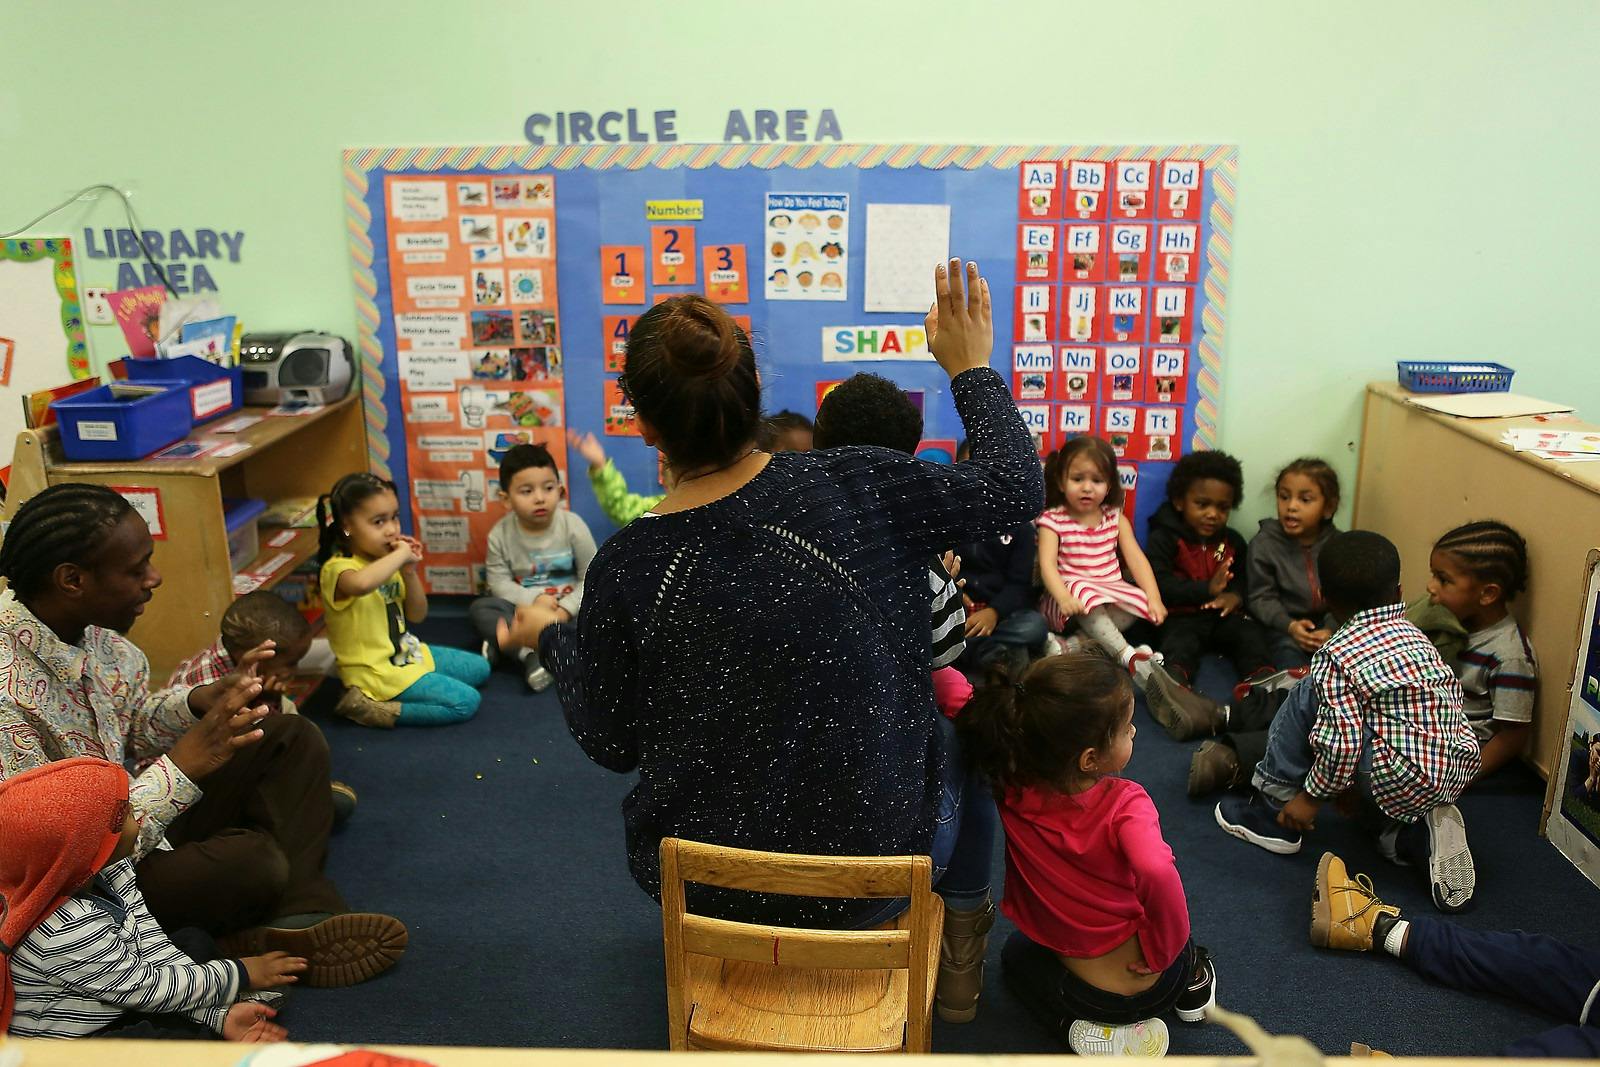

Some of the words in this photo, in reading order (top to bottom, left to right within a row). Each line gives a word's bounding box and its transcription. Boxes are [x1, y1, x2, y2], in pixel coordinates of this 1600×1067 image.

[523, 108, 679, 145] CIRCLE
[723, 109, 843, 142] AREA
[1029, 169, 1053, 185] Aa
[1076, 168, 1101, 185] Bb
[1123, 167, 1145, 184] Cc
[1167, 169, 1193, 185] Dd
[647, 205, 703, 216] Numbers
[84, 227, 245, 263] LIBRARY
[664, 229, 681, 253] 2
[1028, 230, 1049, 246] Ee
[1075, 231, 1092, 247] Ff
[1117, 229, 1140, 249] Gg
[1165, 232, 1190, 248] Hh
[615, 252, 630, 277] 1
[716, 247, 733, 271] 3
[117, 263, 219, 294] AREA
[1030, 291, 1040, 307] Ii
[1076, 292, 1089, 312] Jj
[1115, 293, 1136, 308] Kk
[1164, 295, 1177, 311] Ll
[614, 318, 630, 341] 4
[835, 330, 931, 354] SHAP
[1016, 352, 1051, 368] Mm
[1066, 352, 1091, 367] Nn
[1111, 354, 1136, 369] Oo
[1156, 354, 1179, 372] Pp
[1020, 410, 1045, 428] Qq
[1065, 411, 1085, 426] Rr
[1111, 411, 1130, 427] Ss
[1151, 414, 1169, 429] Tt
